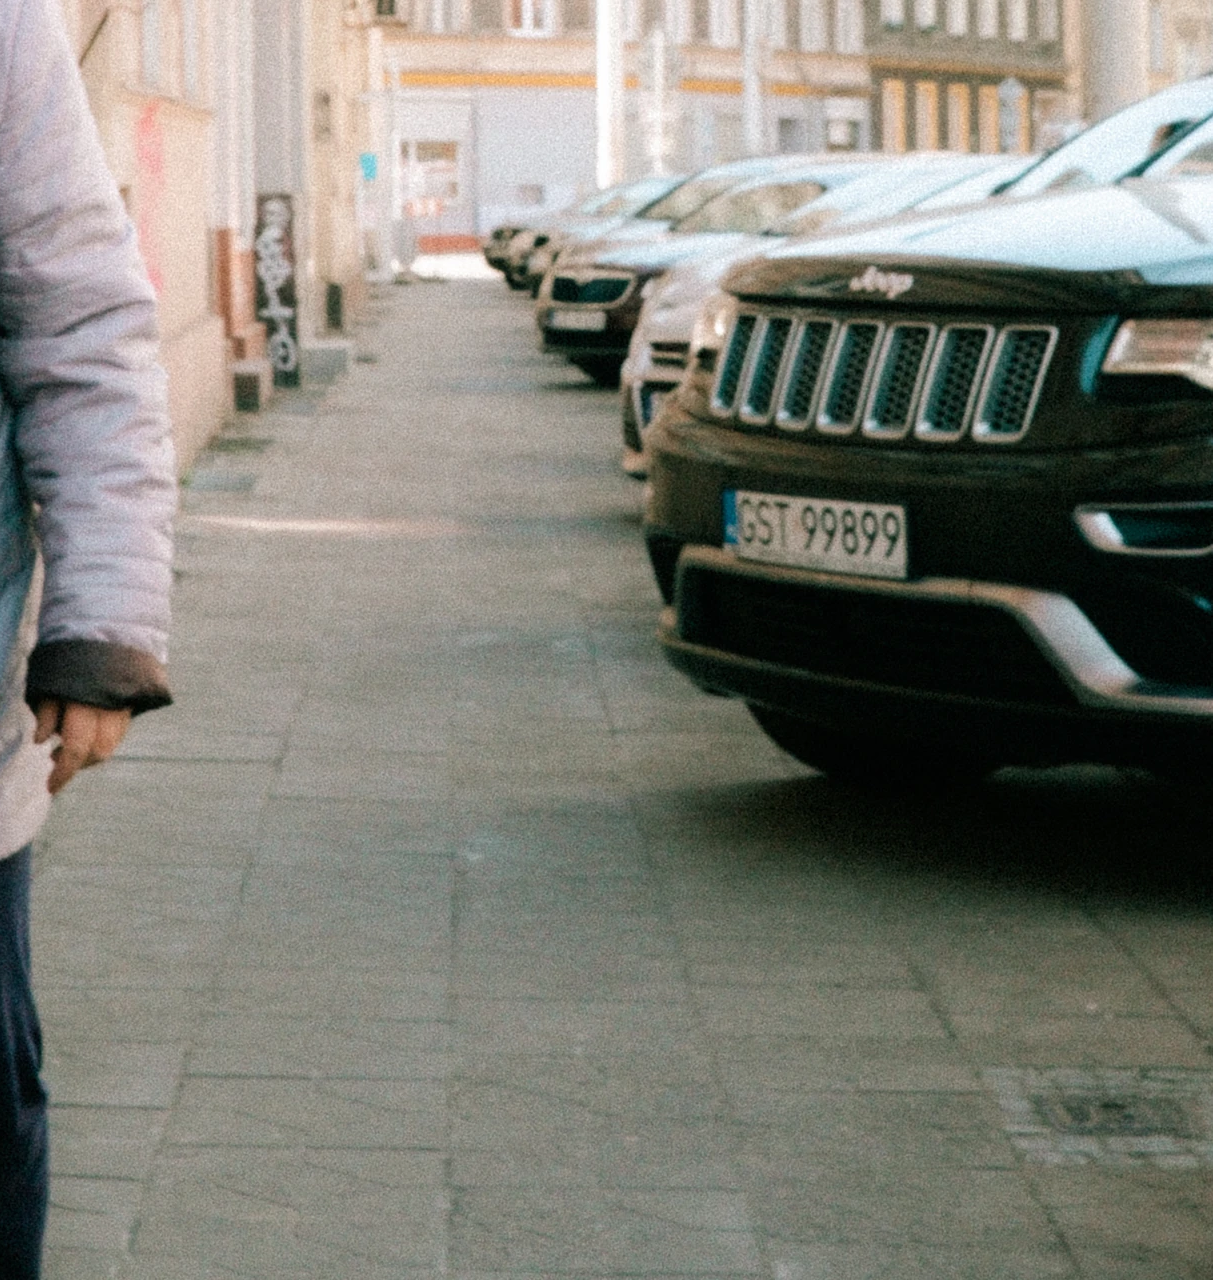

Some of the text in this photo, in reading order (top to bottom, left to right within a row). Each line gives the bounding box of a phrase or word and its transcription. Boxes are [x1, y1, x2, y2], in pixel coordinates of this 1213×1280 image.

[849, 266, 914, 300] Jeep
[739, 497, 901, 558] GST 99899
